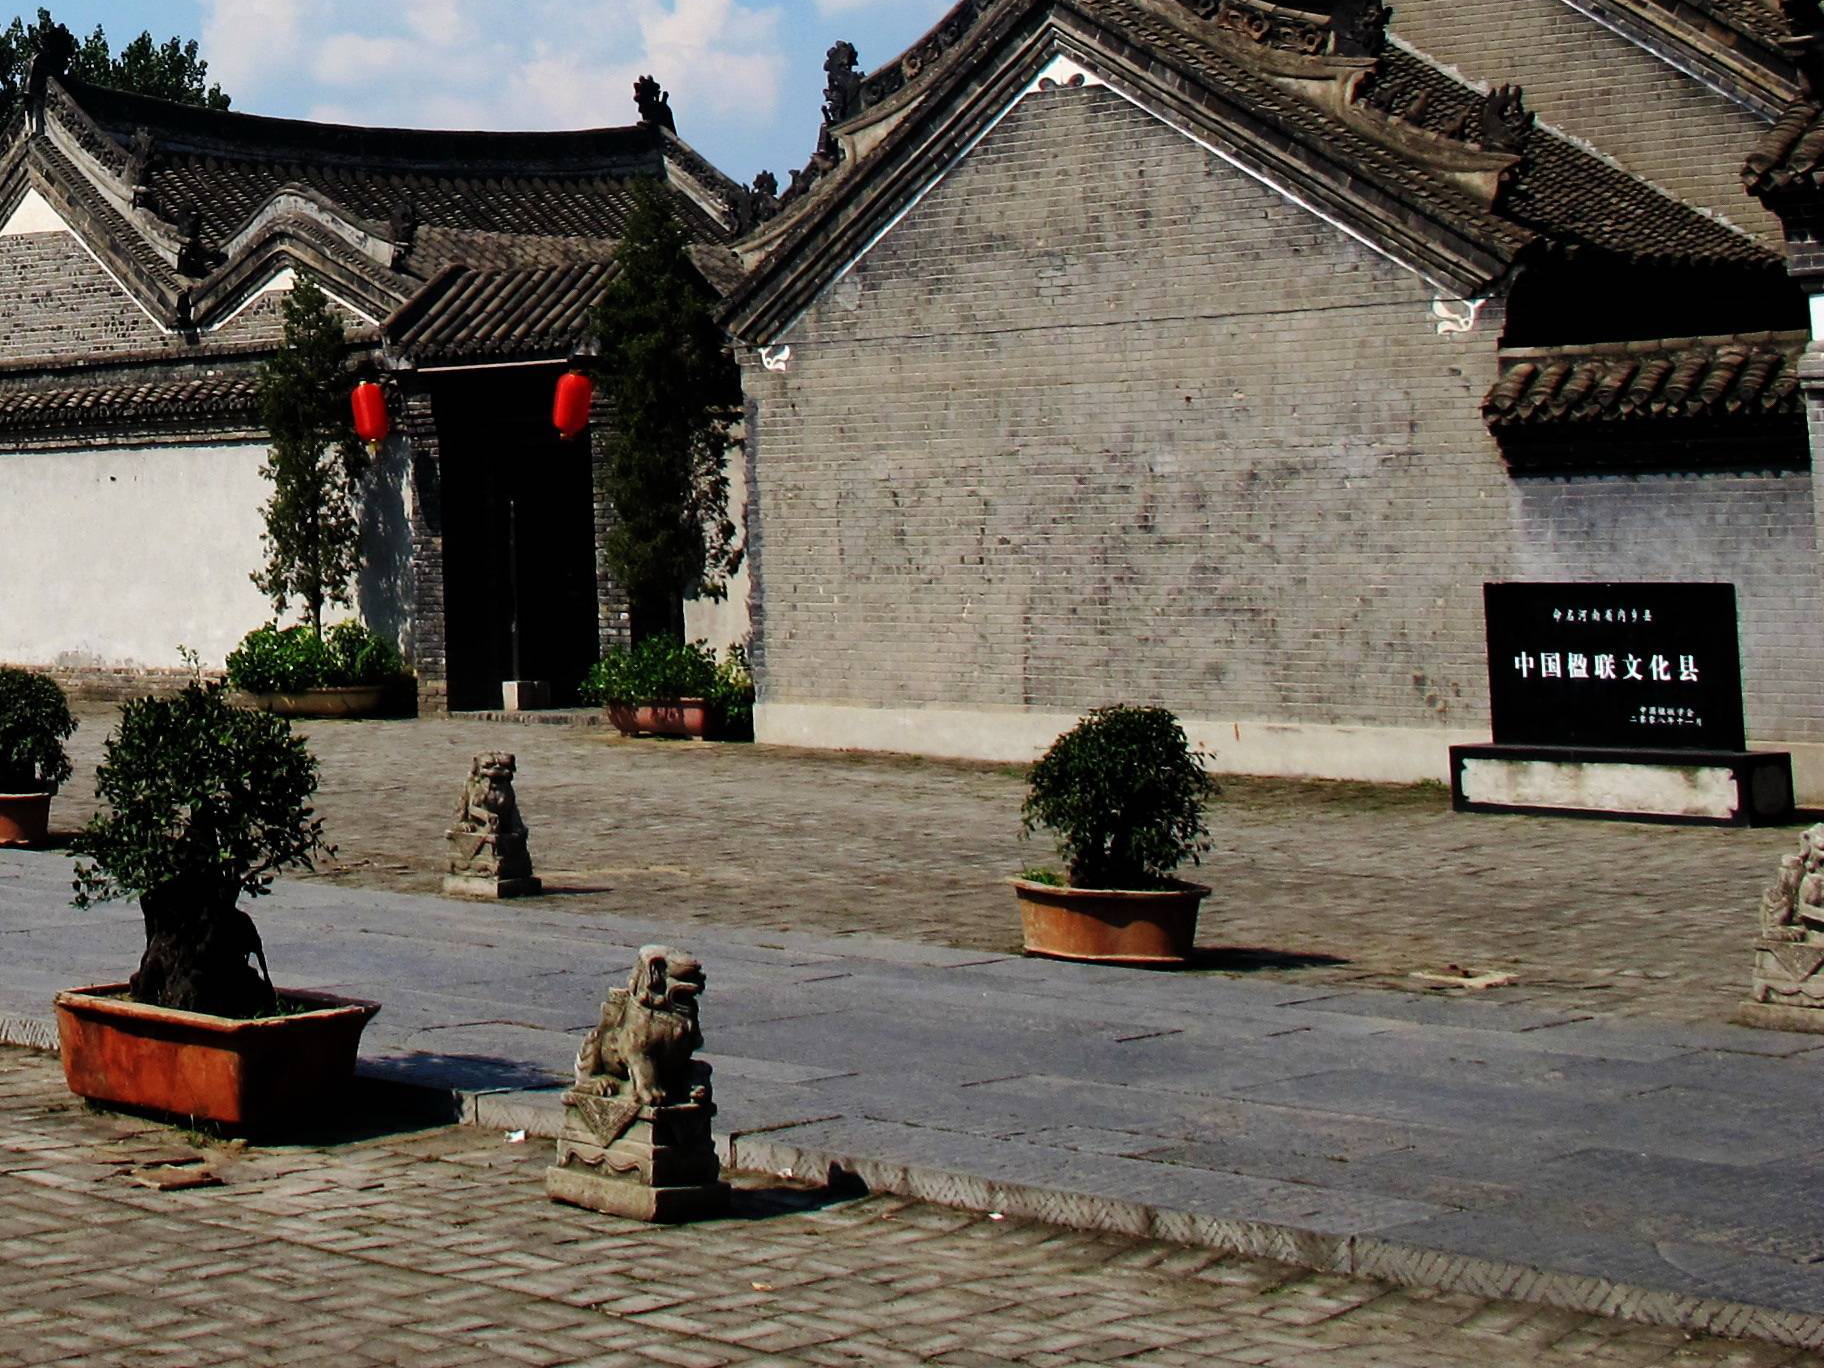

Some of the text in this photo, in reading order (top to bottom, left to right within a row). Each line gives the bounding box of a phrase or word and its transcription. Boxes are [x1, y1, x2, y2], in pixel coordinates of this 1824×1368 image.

[1514, 651, 1700, 682] 中国楹联文化县
